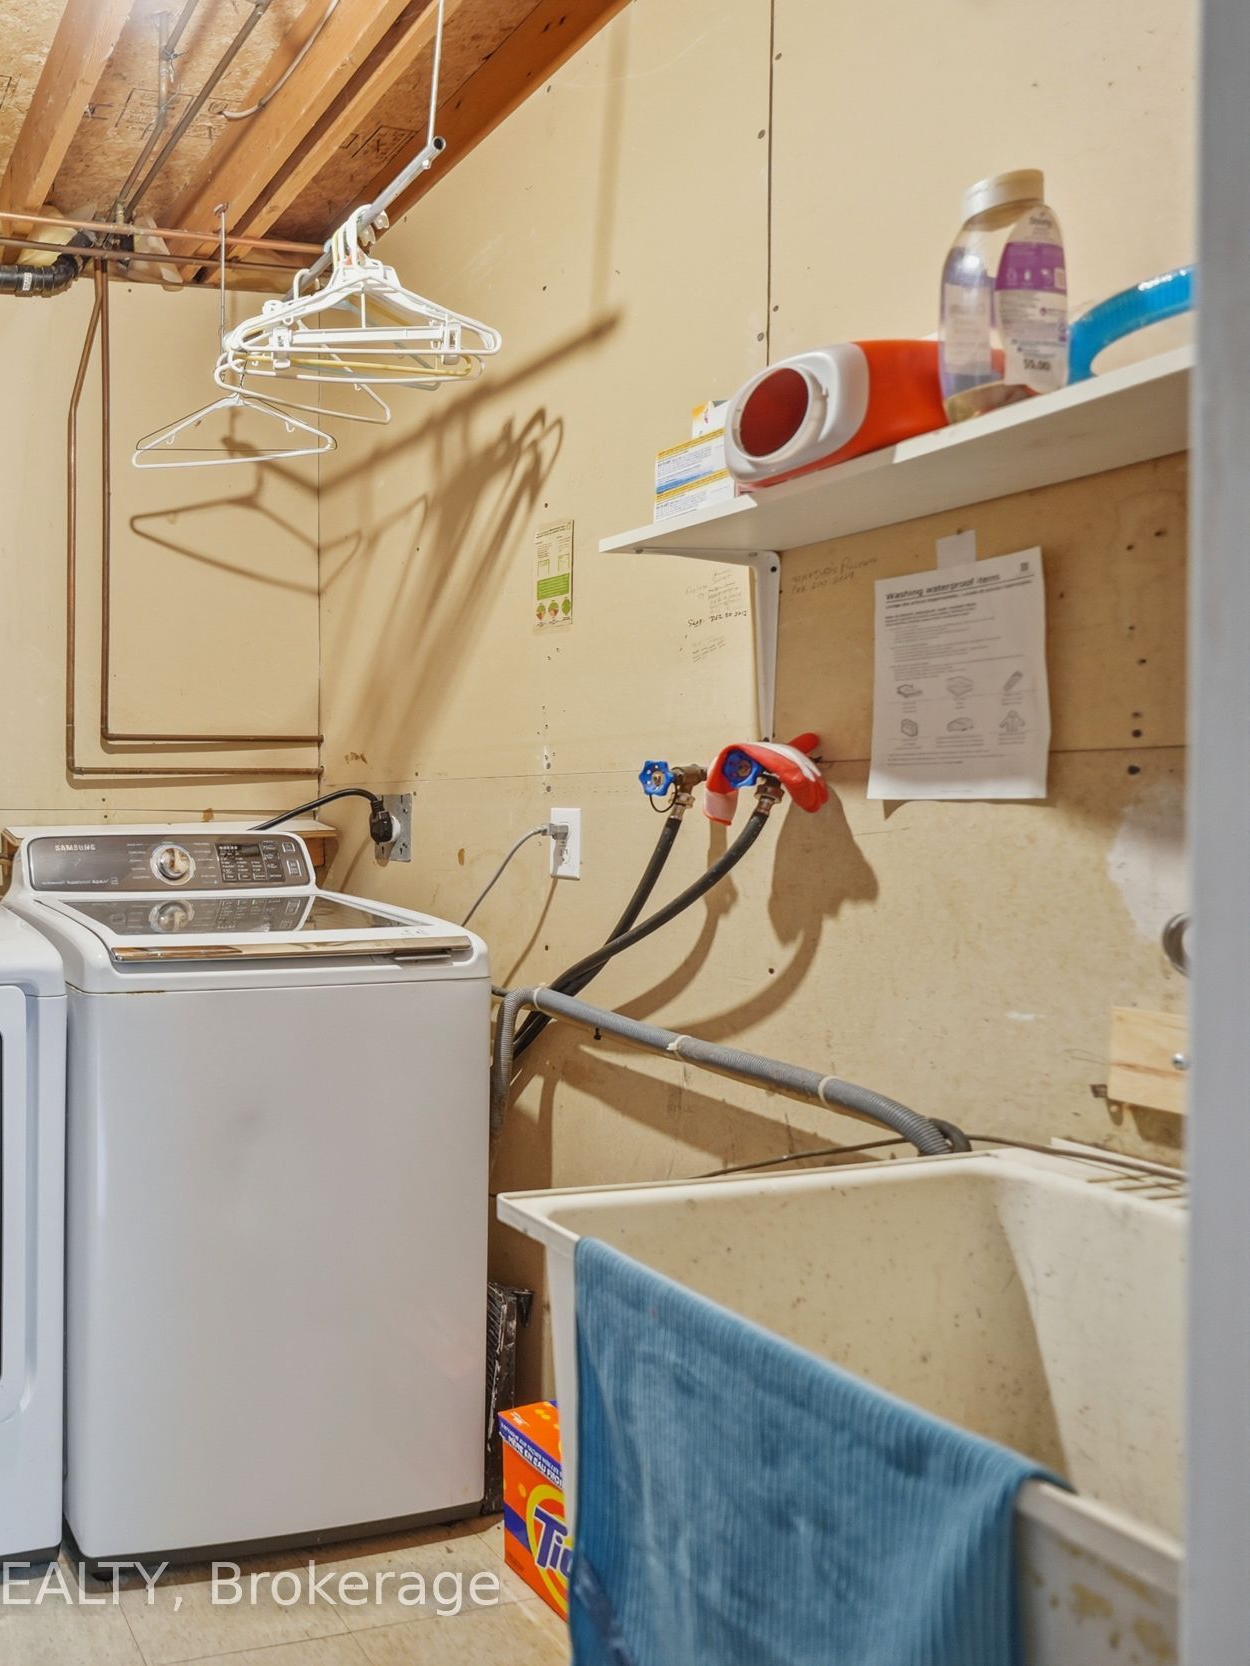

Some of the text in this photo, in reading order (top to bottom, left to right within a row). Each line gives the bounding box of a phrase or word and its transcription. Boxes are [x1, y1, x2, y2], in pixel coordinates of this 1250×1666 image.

[886, 587, 924, 600] Washing
[926, 577, 974, 596] waterproof
[977, 574, 1000, 585] items
[54, 843, 96, 852] SAMSUNG
